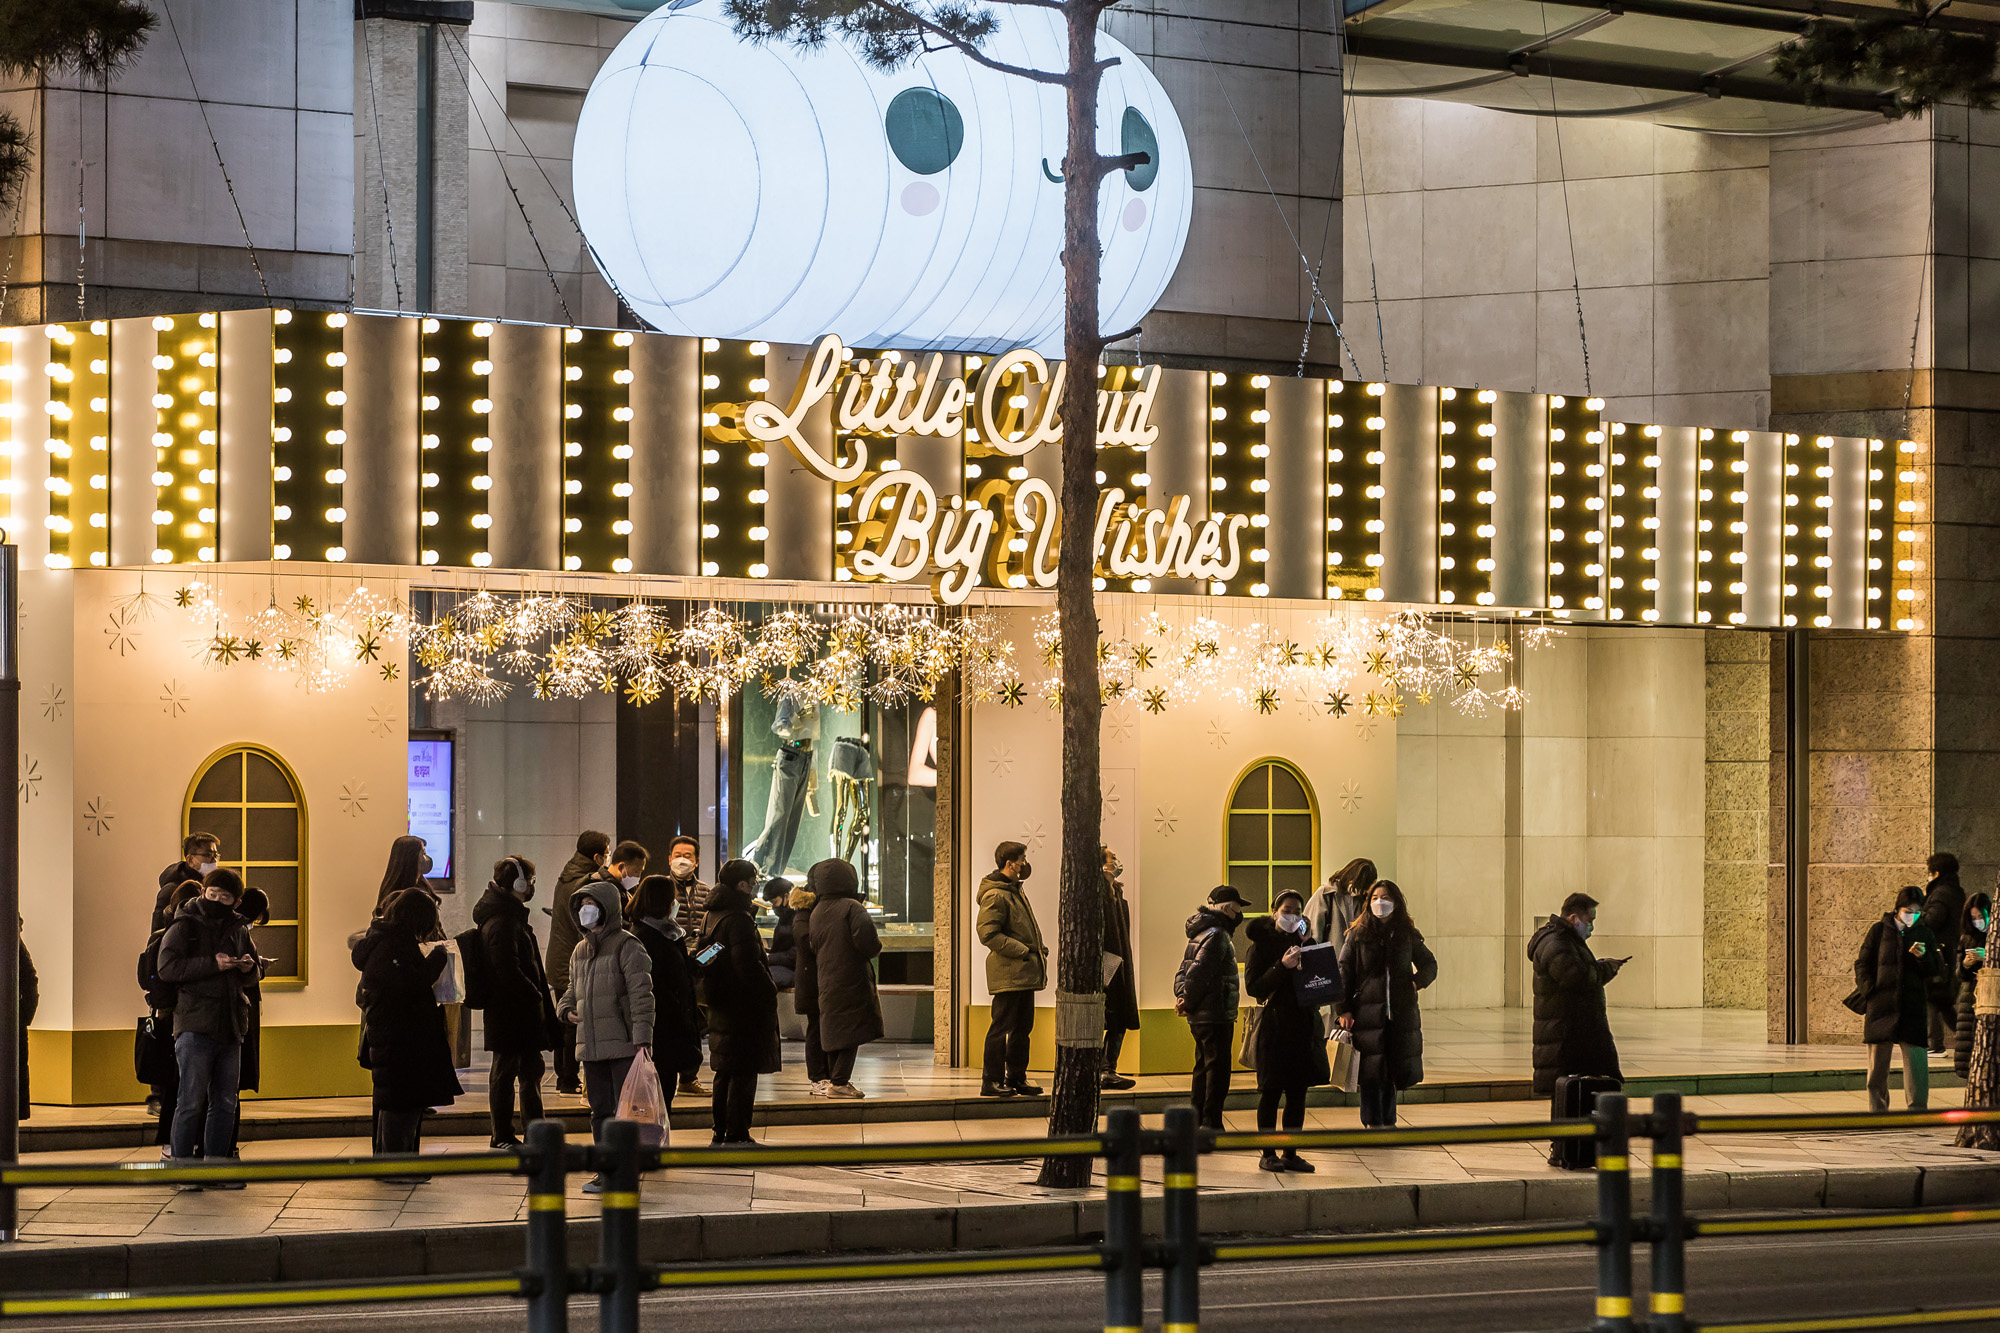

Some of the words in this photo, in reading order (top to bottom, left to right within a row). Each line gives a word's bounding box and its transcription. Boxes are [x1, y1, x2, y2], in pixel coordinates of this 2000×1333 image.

[741, 333, 964, 483] Little
[976, 348, 1162, 456] Clud
[848, 469, 996, 606] Big
